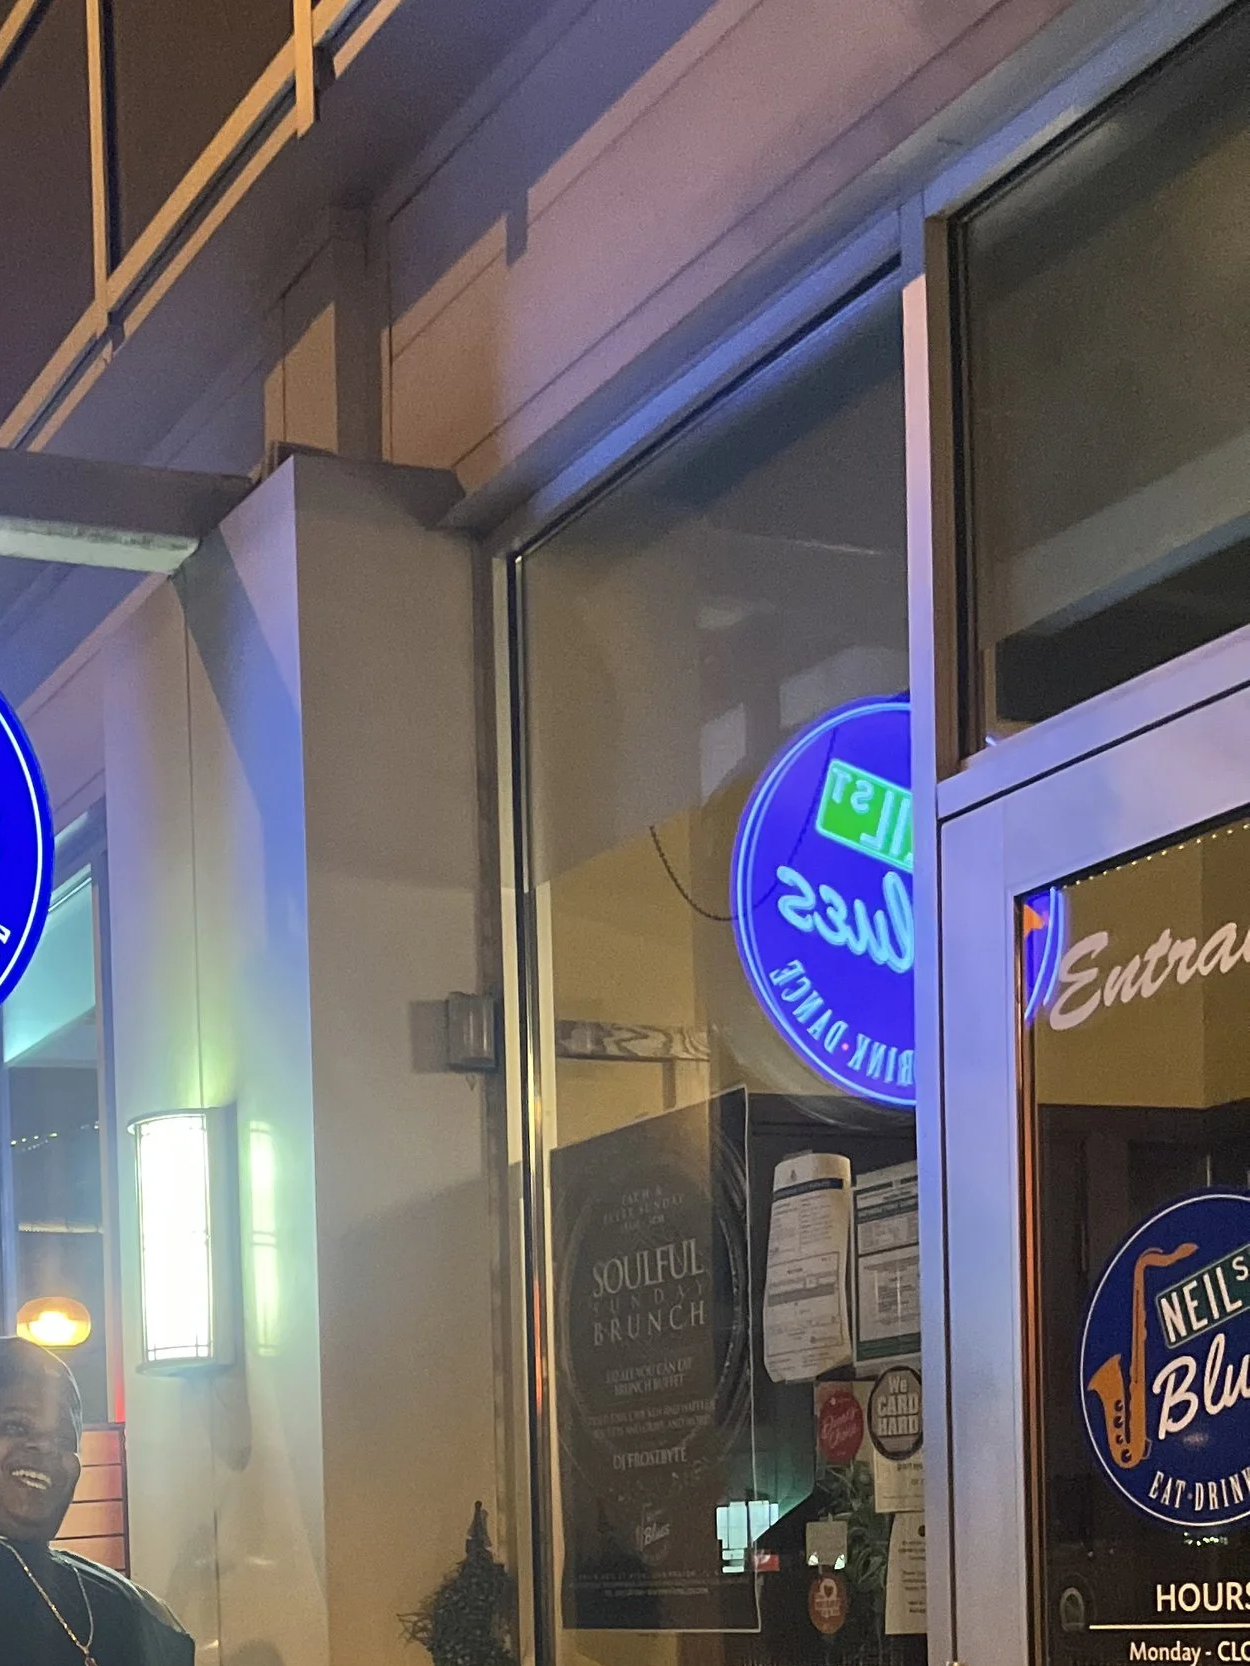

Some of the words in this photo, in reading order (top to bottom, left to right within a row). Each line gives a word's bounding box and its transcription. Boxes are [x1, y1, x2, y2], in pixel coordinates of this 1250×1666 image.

[1050, 922, 1250, 1030] Entra
[592, 1238, 704, 1298] SOULFUL
[593, 1300, 706, 1346] BRUNCH
[1160, 1266, 1243, 1343] NEIL
[877, 1392, 919, 1416] CARD
[889, 1376, 908, 1393] We
[877, 1415, 919, 1436] HARD
[1148, 1471, 1187, 1508] EAT
